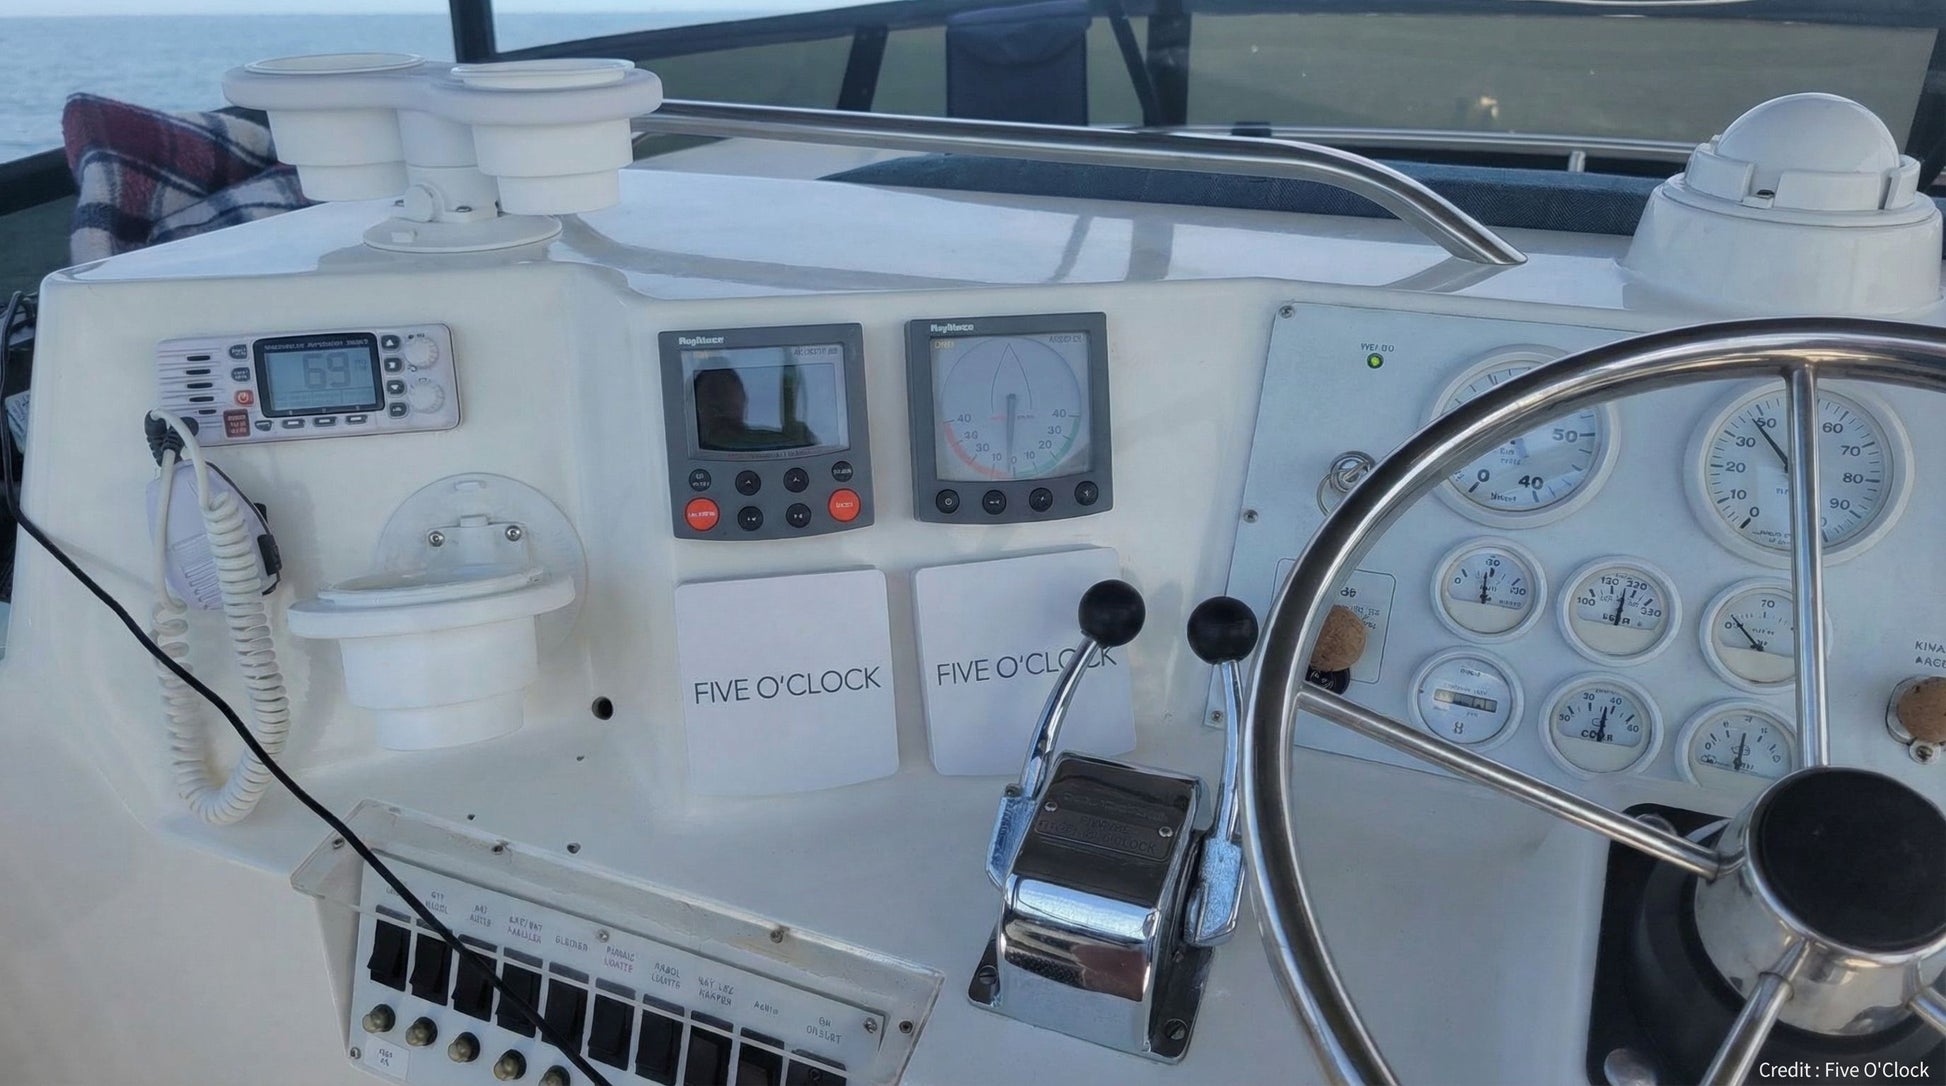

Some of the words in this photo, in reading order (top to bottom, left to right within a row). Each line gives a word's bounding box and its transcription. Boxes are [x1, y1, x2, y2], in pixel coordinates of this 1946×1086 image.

[302, 352, 351, 389] 69
[957, 414, 972, 423] 40
[1051, 408, 1067, 418] 40
[1047, 425, 1062, 435] 30
[1822, 422, 1844, 434] 60
[1552, 428, 1578, 443] 50
[975, 442, 991, 453] 30
[1038, 439, 1053, 450] 20
[1735, 436, 1756, 448] 30
[992, 452, 1002, 462] 10
[1840, 445, 1861, 457] 70
[1725, 461, 1746, 473] 20
[1477, 468, 1490, 483] 0
[1842, 472, 1864, 484] 80
[1518, 474, 1544, 490] 40
[1730, 489, 1747, 500] 10
[1829, 498, 1851, 511] 90
[1749, 506, 1760, 518] 0
[1577, 597, 1596, 606] 100
[1761, 600, 1775, 608] 70
[936, 659, 990, 686] FIVE
[694, 679, 750, 704] FIVE
[756, 666, 881, 699] O'CLOCK
